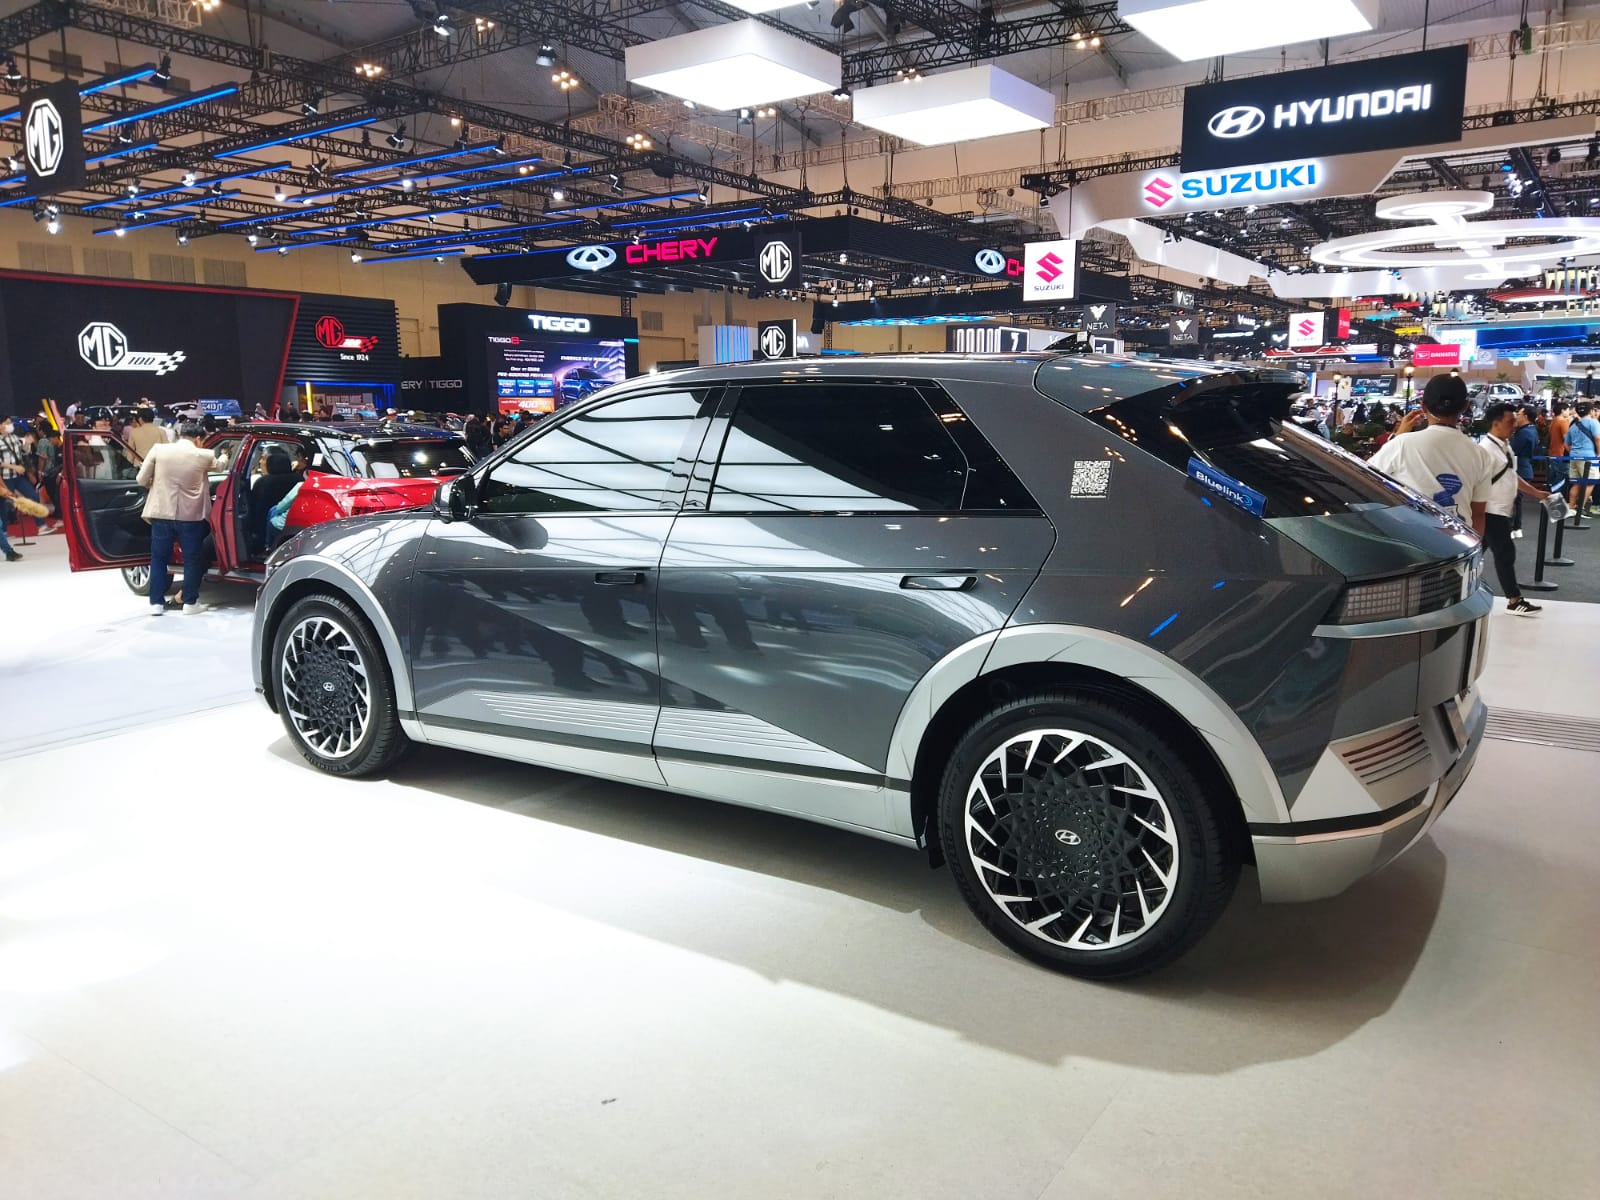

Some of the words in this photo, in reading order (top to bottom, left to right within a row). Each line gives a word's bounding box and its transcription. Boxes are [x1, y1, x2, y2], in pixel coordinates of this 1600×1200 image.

[1273, 83, 1432, 129] HYUNDAI
[27, 100, 63, 175] MG
[1181, 164, 1316, 199] SUZUKI
[626, 237, 718, 264] CHERY
[761, 242, 791, 281] MG
[316, 316, 344, 348] MG
[527, 314, 590, 333] TIGGO
[1086, 322, 1109, 330] NETA
[79, 323, 127, 369] MG
[128, 356, 156, 366] 100
[761, 326, 786, 358] MG
[429, 379, 463, 389] TIGGO
[1195, 470, 1245, 504] Bluelink
